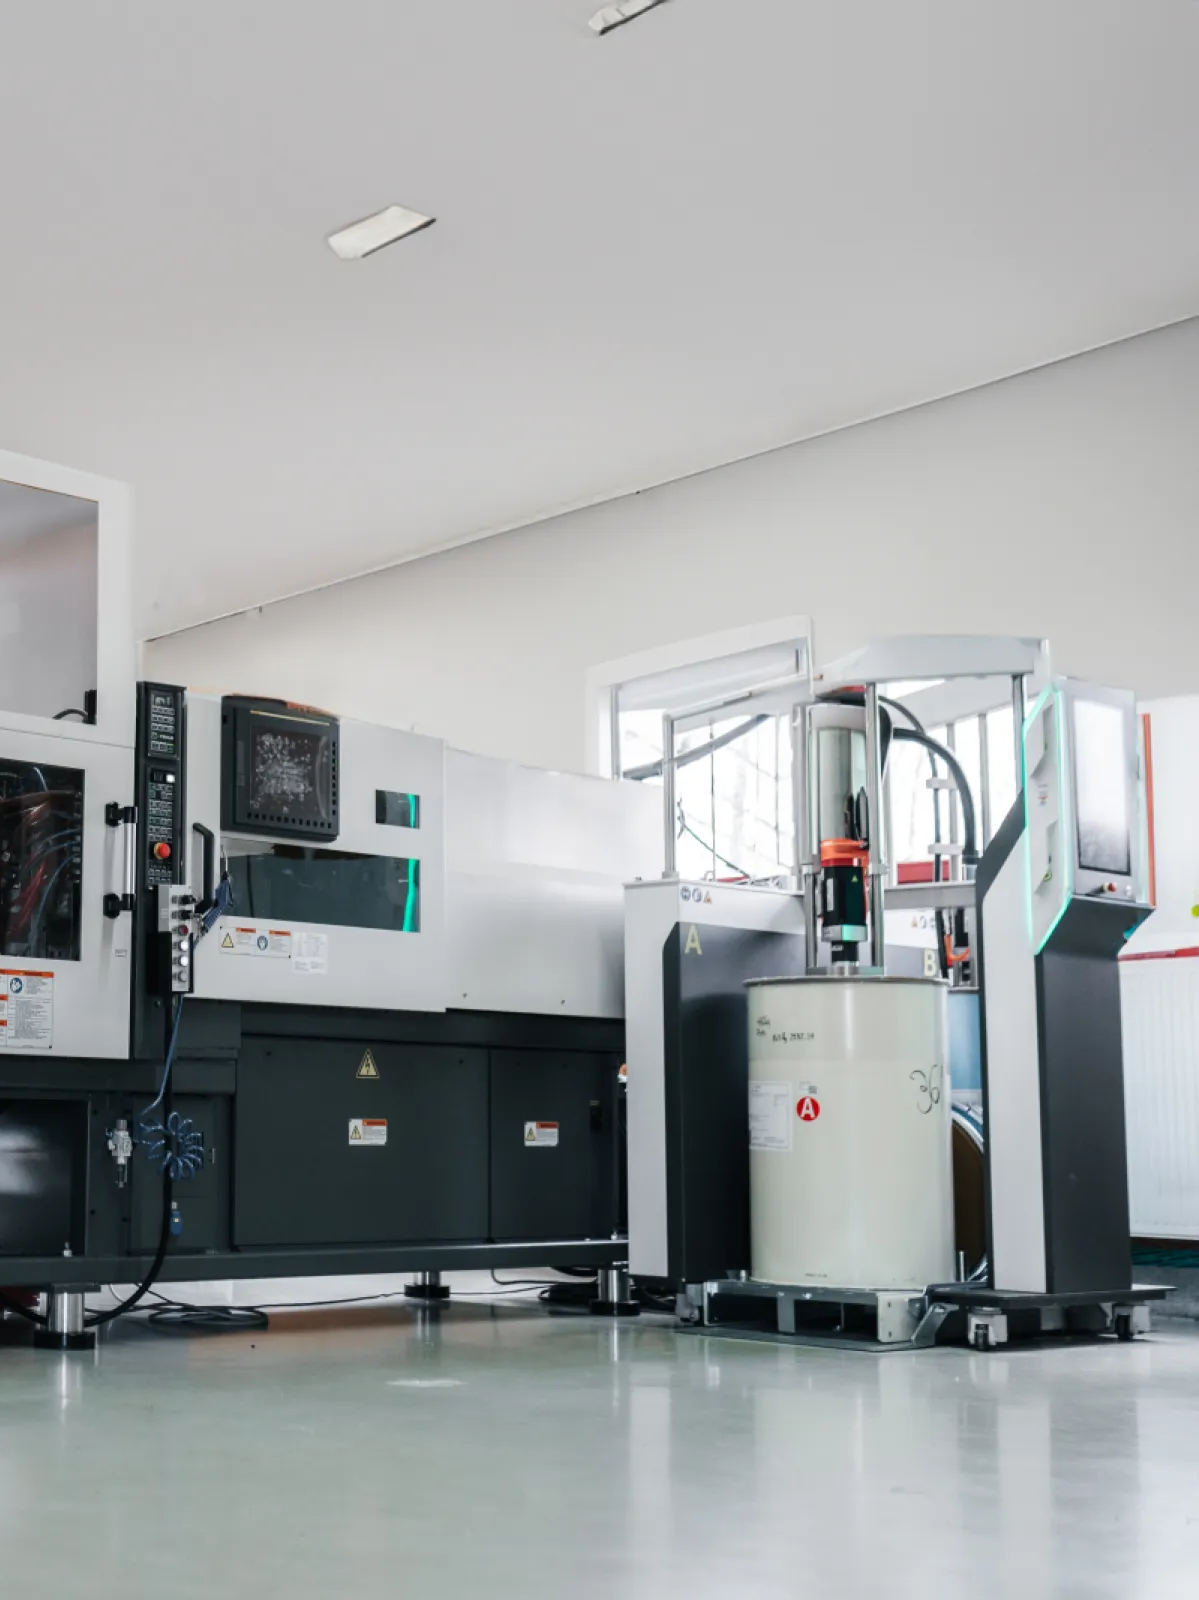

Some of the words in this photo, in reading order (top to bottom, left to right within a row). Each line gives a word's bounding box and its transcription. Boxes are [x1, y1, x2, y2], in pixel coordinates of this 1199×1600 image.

[684, 923, 703, 955] A
[924, 948, 936, 977] B
[800, 1097, 815, 1118] A
